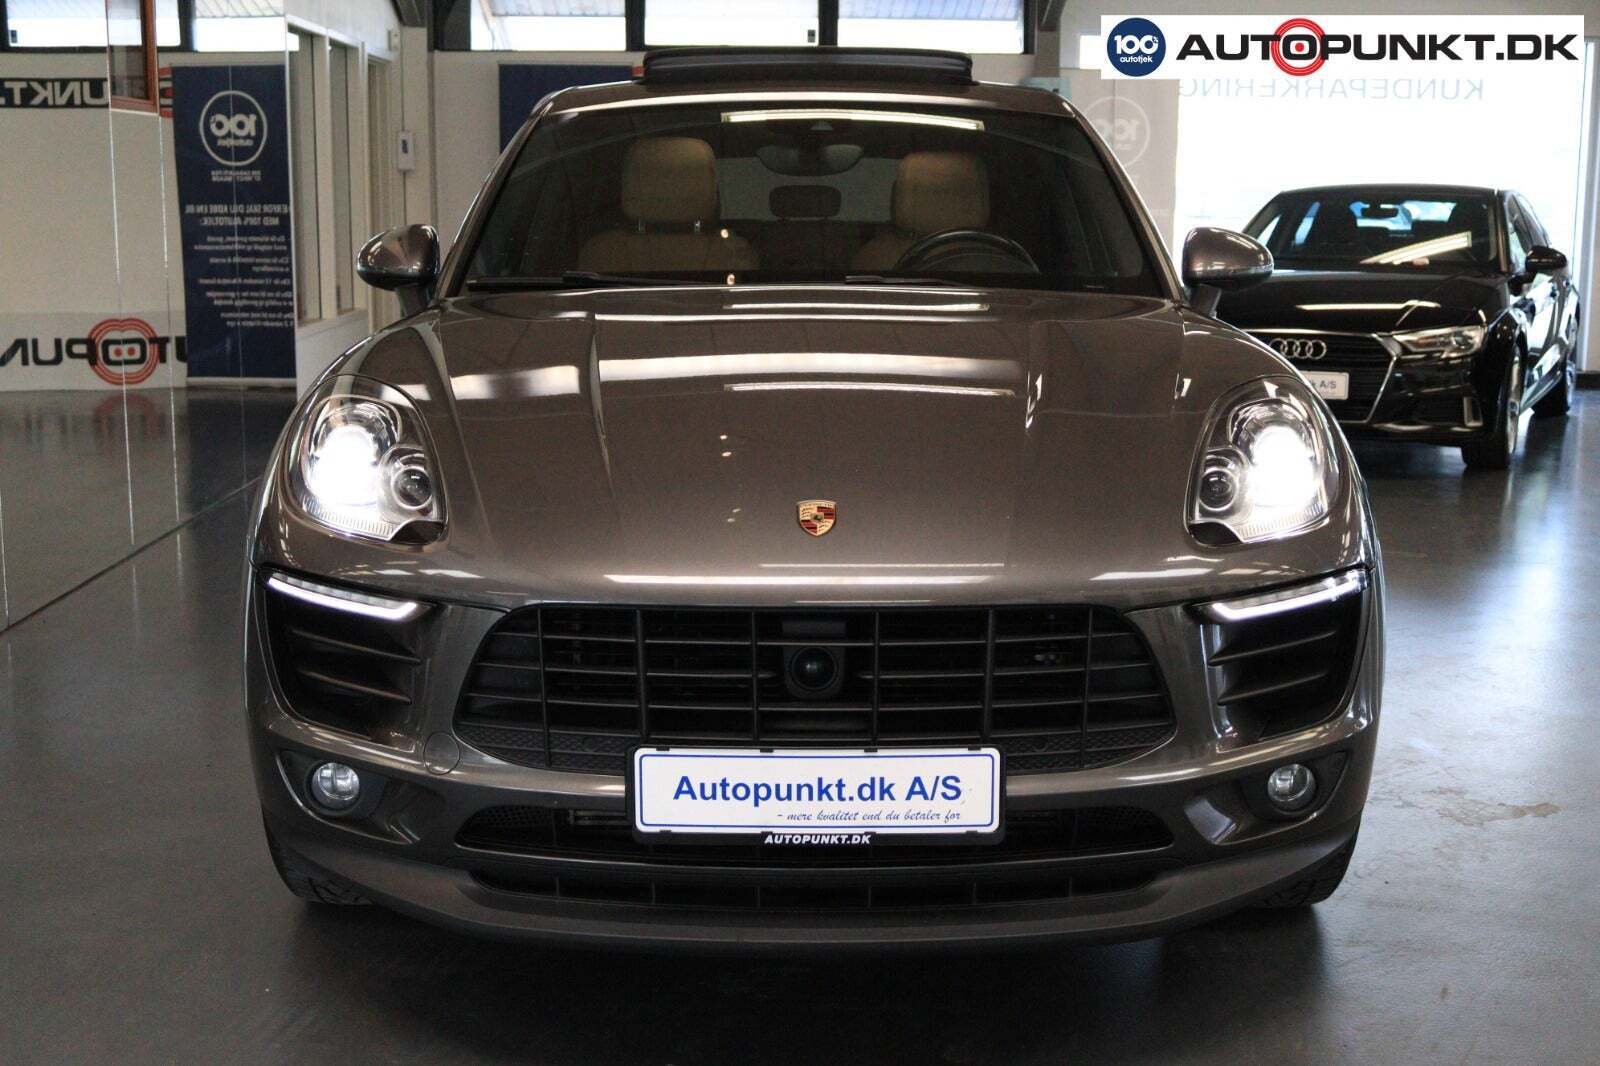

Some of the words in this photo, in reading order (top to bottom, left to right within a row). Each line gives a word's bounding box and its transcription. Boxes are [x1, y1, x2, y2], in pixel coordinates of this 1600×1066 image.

[673, 775, 896, 807] Autopunkt.dk
[905, 775, 962, 802] A/S
[787, 813, 813, 822] mere
[816, 808, 859, 822] kvalitet
[862, 811, 882, 822] end
[886, 810, 900, 822] du
[904, 808, 941, 821] betaler
[764, 834, 872, 845] AUTOPUNKT.DK
